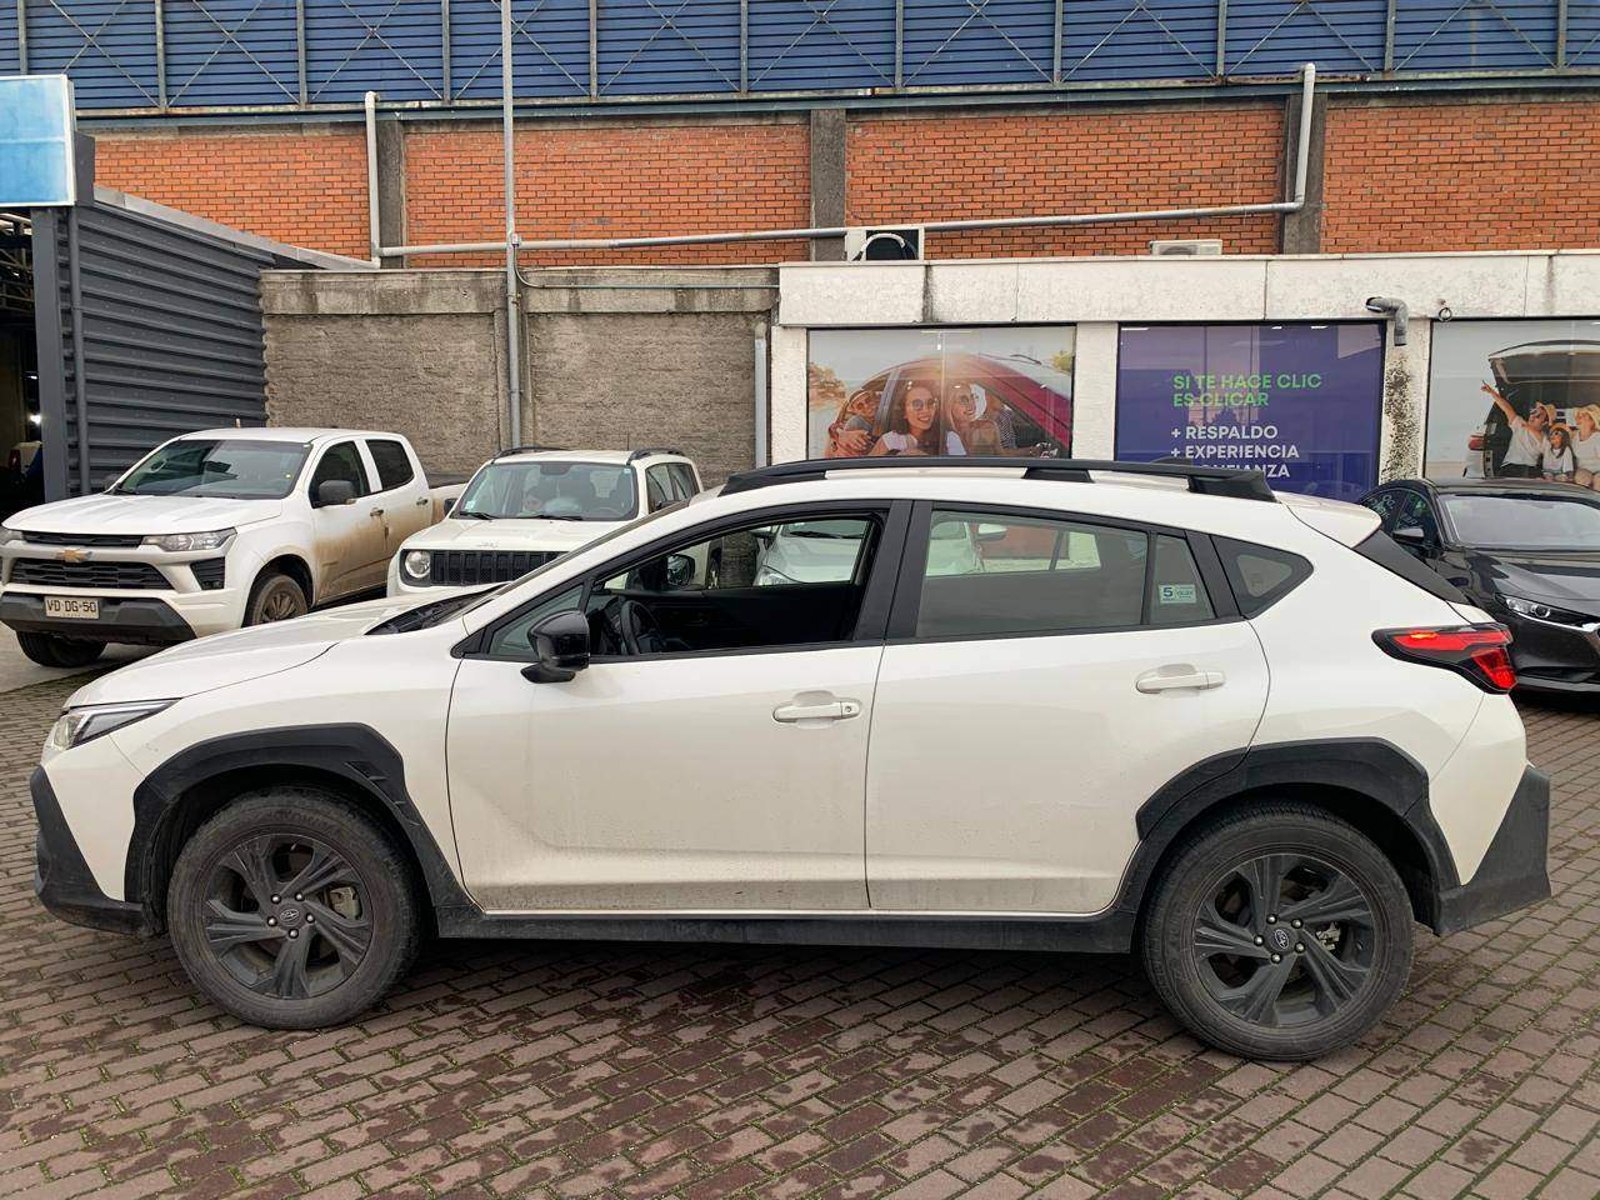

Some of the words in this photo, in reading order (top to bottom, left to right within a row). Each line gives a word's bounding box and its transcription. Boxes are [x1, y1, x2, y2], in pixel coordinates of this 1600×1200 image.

[1173, 375, 1190, 389] SI
[1196, 375, 1215, 389] TE
[1221, 375, 1272, 388] HACE
[1277, 374, 1322, 388] CLIC
[1173, 393, 1194, 407] ES
[1200, 392, 1269, 407] CLICAR
[1185, 425, 1278, 440] RESPALDO
[1185, 445, 1300, 459] EXPERIENCIA
[1163, 587, 1173, 597] 5
